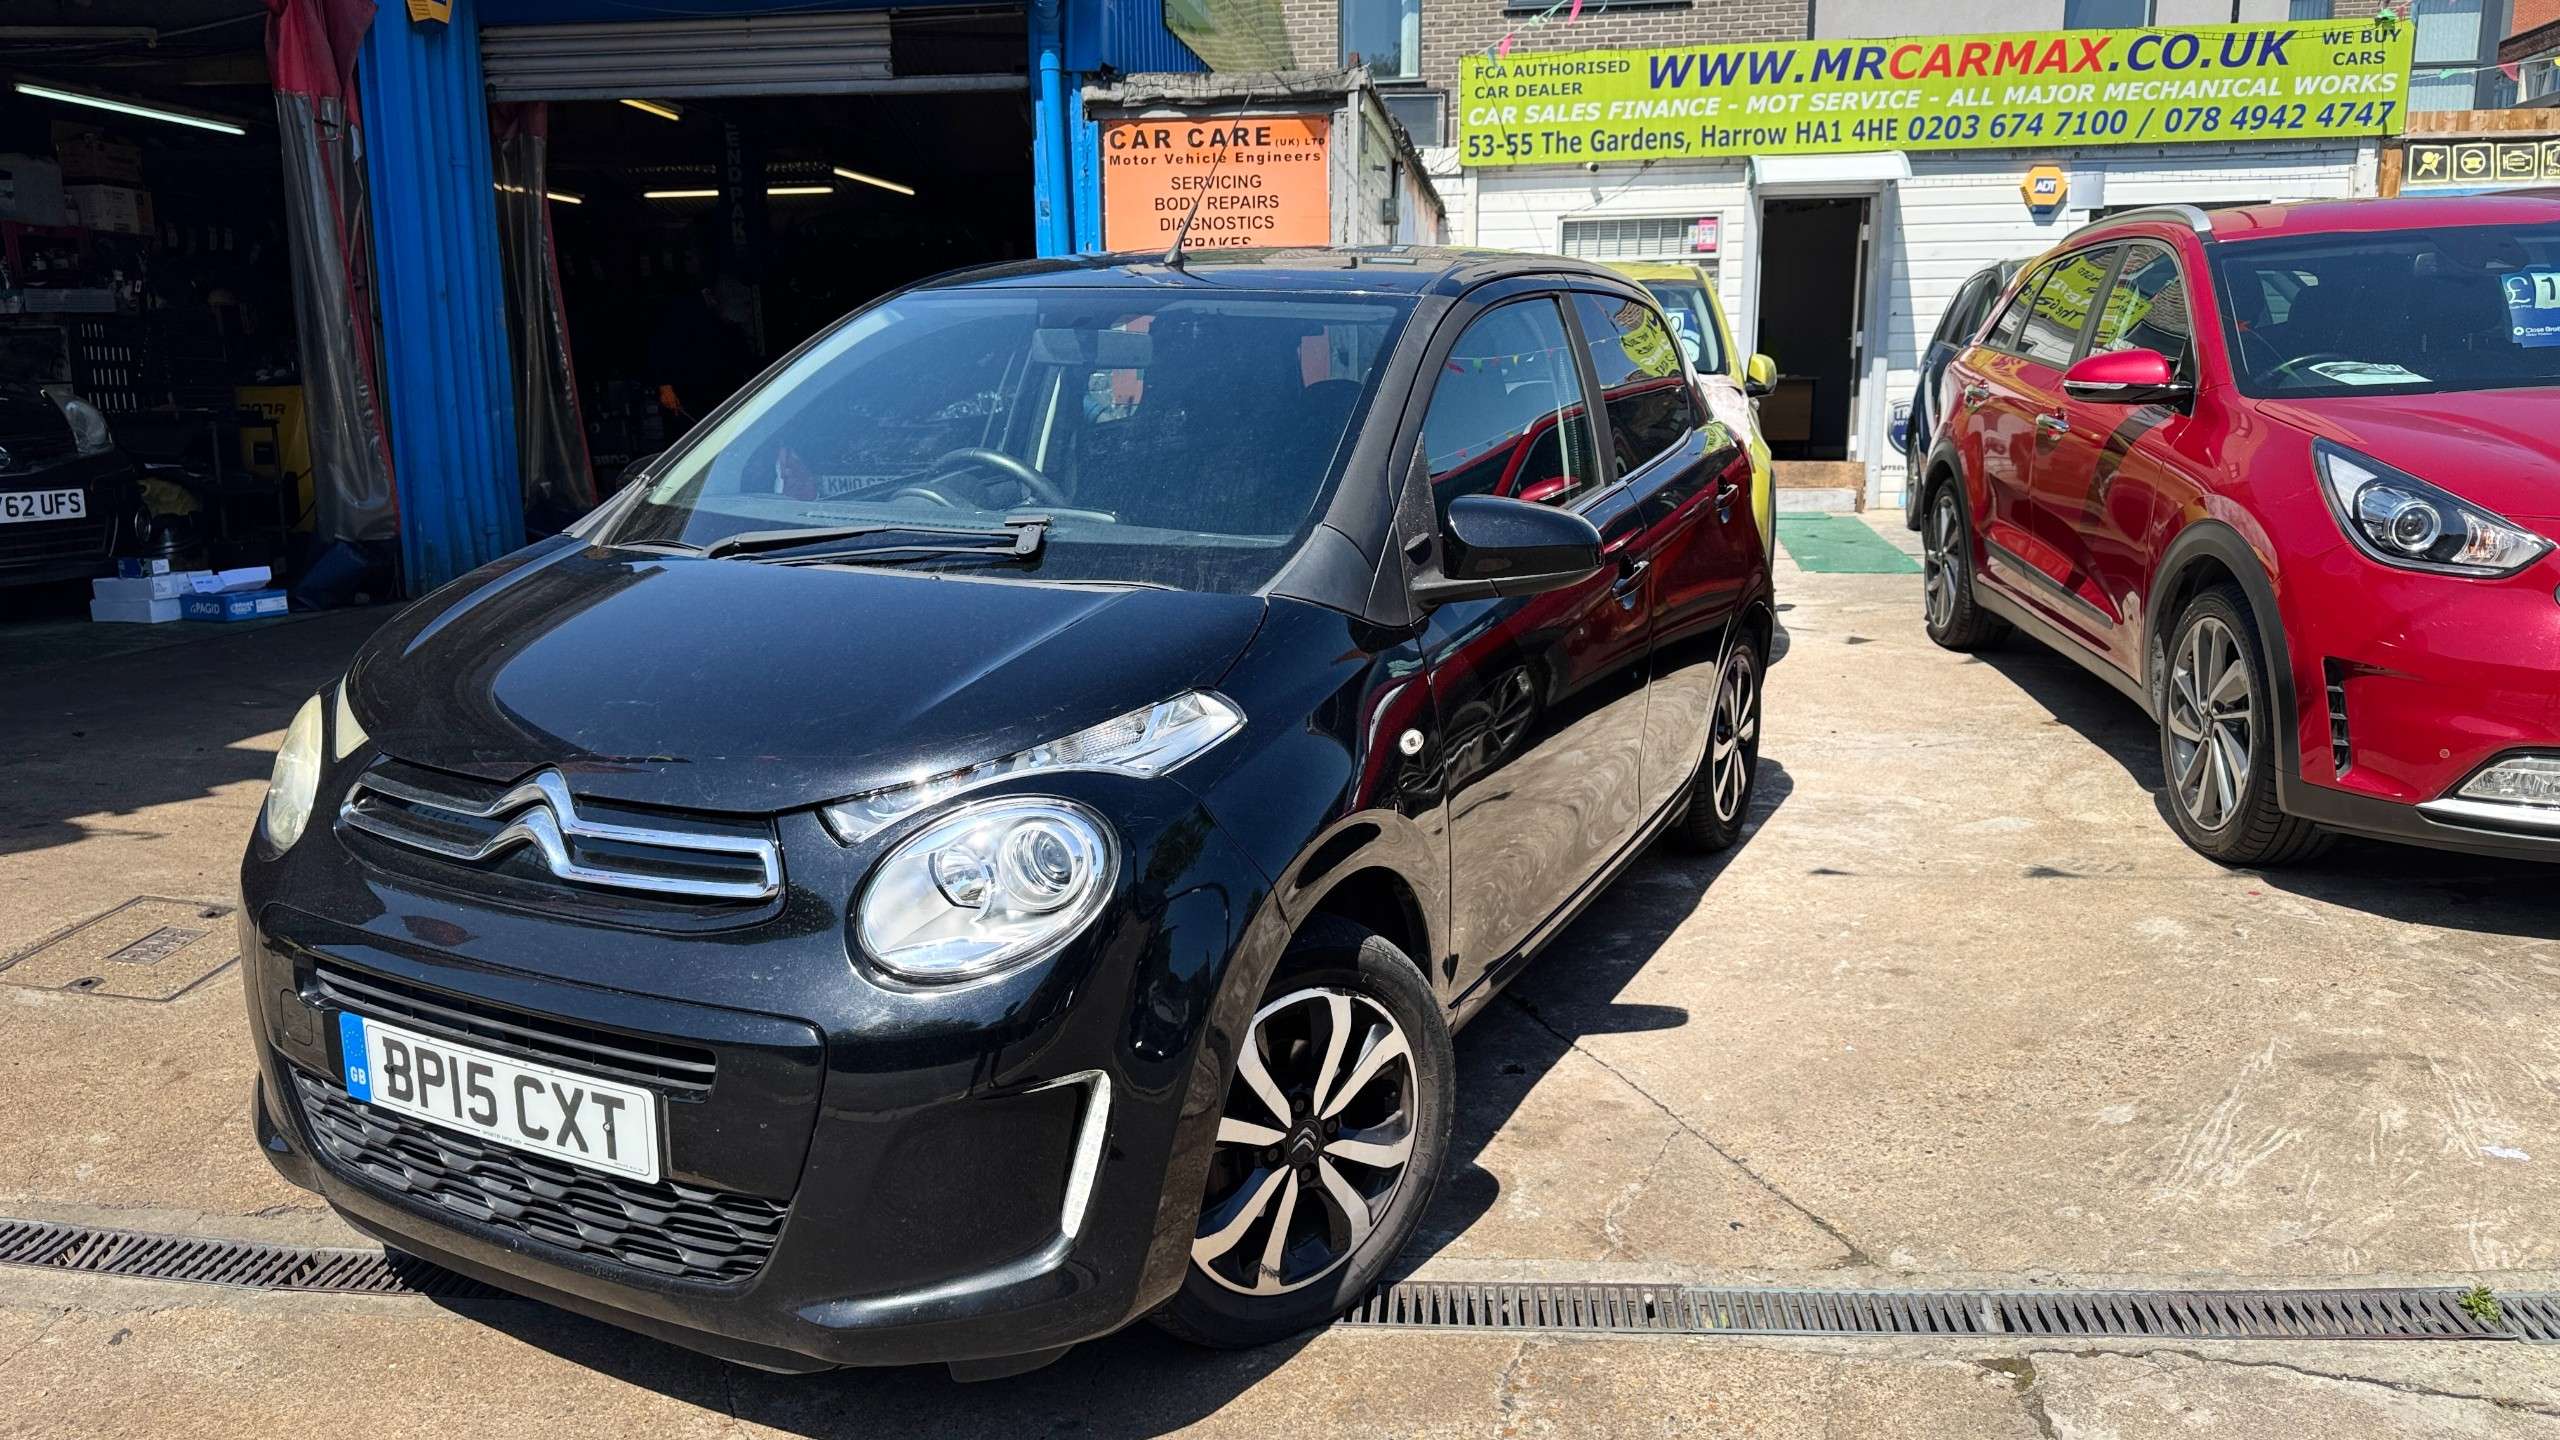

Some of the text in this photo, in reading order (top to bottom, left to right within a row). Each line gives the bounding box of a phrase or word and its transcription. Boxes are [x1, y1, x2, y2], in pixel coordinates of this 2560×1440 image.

[2322, 28, 2402, 46] WE BUY
[1649, 29, 2297, 89] WWW.MRCARMAX.CO.UK
[2332, 50, 2386, 66] CARS
[1475, 60, 1630, 80] FCA AUTHORISED
[1468, 103, 1516, 126] CAR
[1524, 101, 1601, 123] SALES
[1608, 97, 1720, 120] FINANCE
[1746, 94, 1803, 115] MOT
[1808, 89, 1921, 111] SERVICE
[1946, 86, 1993, 108] ALL
[2003, 82, 2095, 105] MAJOR
[2102, 76, 2282, 102] MECHANICAL
[2292, 72, 2398, 95] WORKS
[1475, 81, 1583, 99] CAR DEALER
[1109, 126, 1325, 151] CAR CARE (UK) LTD
[1467, 133, 1533, 158] 53-55
[1541, 130, 1582, 155] The
[1590, 126, 1690, 153] Gardens,
[1701, 123, 1787, 148] Harrow
[1795, 119, 1842, 144] HA1
[1852, 118, 1898, 142] 4HE
[1908, 114, 1979, 141] 0203
[1989, 112, 2044, 138] 674
[2055, 108, 2128, 135] 7100
[2164, 105, 2221, 132] 078
[2229, 103, 2305, 130] 4942
[2314, 100, 2396, 128] 4747
[1109, 151, 1321, 166] Motor Vehicle Engineers
[1171, 174, 1262, 190] SERVICING
[2035, 180, 2056, 193] ADT
[1155, 195, 1279, 211] BODY REPAIRS
[1160, 215, 1275, 232] DIAGNOSTICS
[40, 492, 81, 516] UFS
[349, 1065, 368, 1086] GB
[382, 1035, 627, 1161] BP15 CXT
